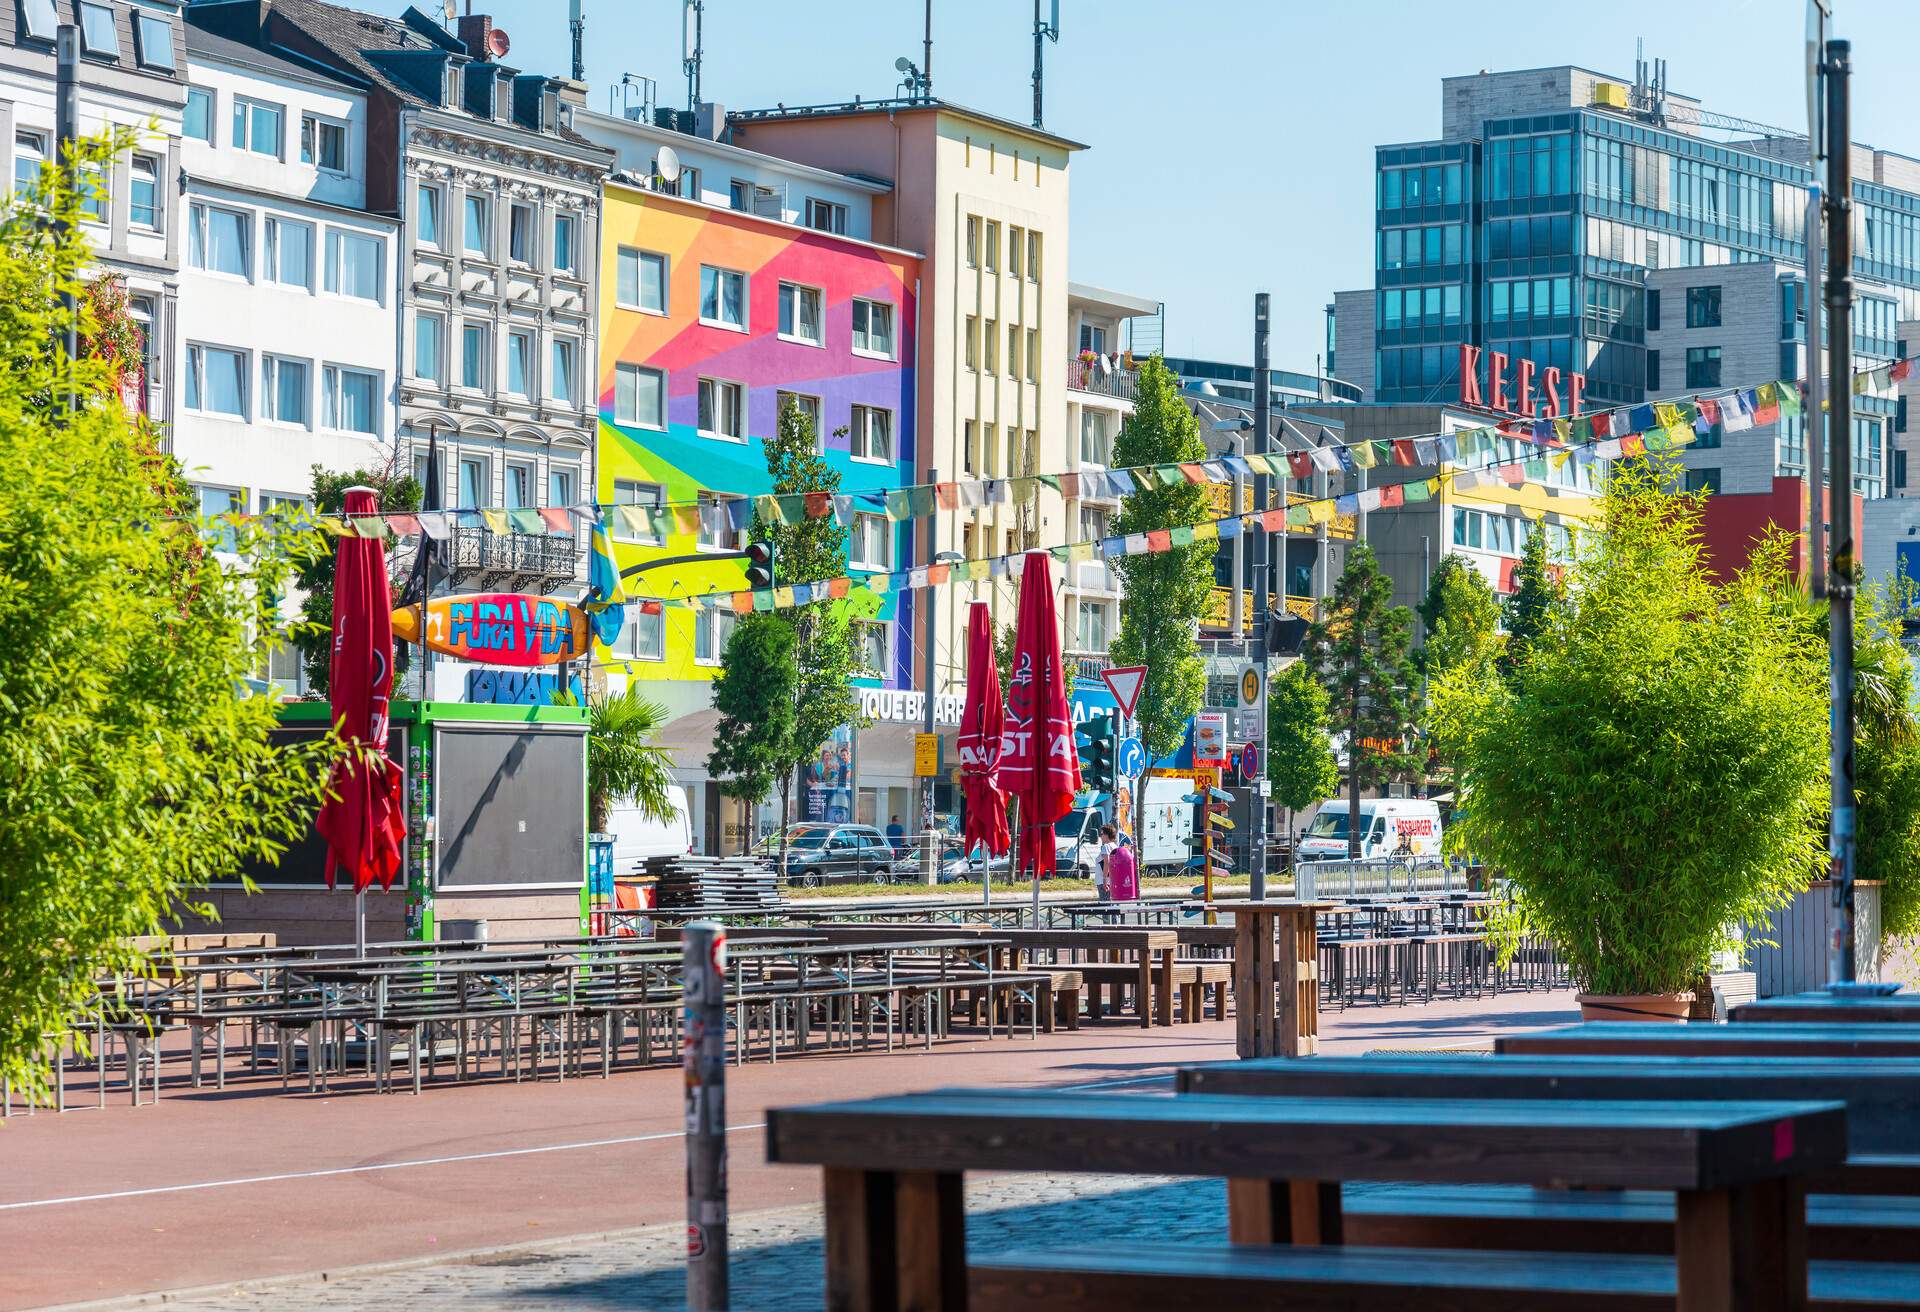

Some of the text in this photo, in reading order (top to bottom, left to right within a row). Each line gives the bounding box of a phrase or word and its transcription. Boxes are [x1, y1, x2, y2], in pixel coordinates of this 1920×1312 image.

[1459, 343, 1586, 419] KEESE
[450, 600, 575, 654] PURA VIDA
[1396, 817, 1433, 838] HESBURGER
